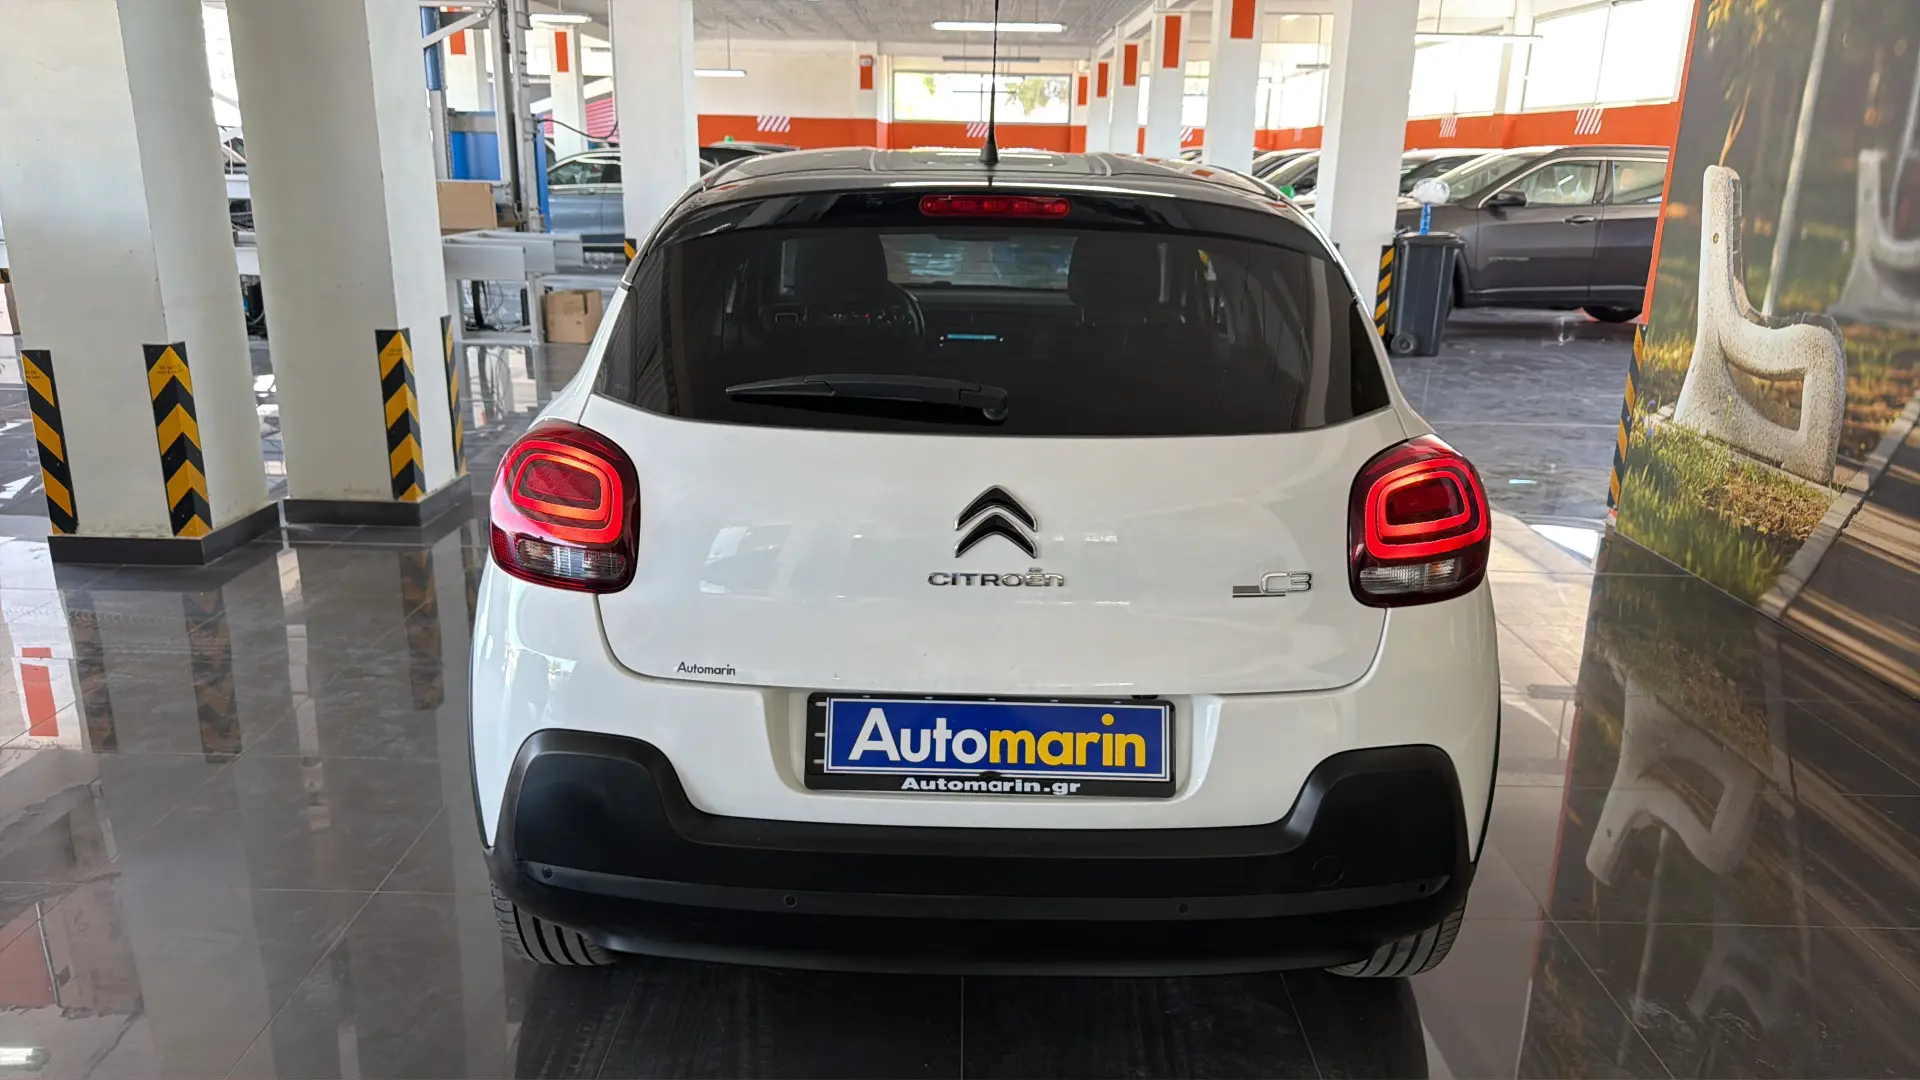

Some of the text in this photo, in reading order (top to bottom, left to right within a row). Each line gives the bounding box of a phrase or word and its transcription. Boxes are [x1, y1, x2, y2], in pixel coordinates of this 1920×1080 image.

[1261, 571, 1312, 594] C3
[677, 661, 736, 676] Automarin
[848, 707, 1146, 767] Automarin
[901, 777, 1081, 796] Automarin.gr
